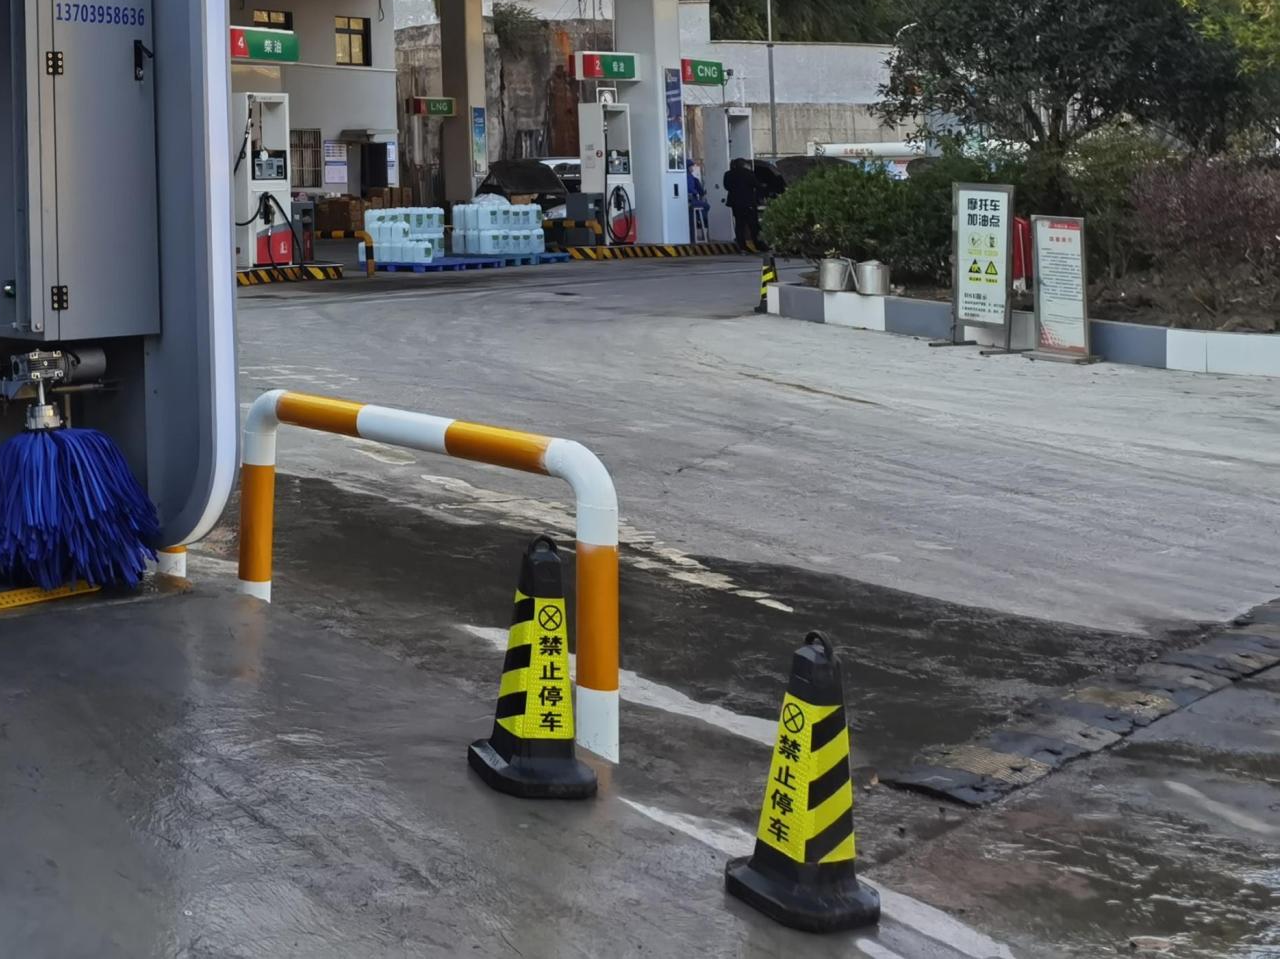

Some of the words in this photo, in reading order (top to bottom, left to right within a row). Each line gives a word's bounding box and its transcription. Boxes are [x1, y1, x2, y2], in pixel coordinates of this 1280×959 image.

[56, 2, 145, 26] 13703958636
[238, 36, 245, 48] 4
[264, 39, 282, 54] 柴油
[697, 64, 718, 78] CNG
[430, 102, 448, 111] LNG
[967, 198, 1000, 211] 摩托车
[967, 214, 1000, 227] 加油点
[538, 635, 563, 733] 禁止停车
[767, 734, 802, 843] 禁止停车
